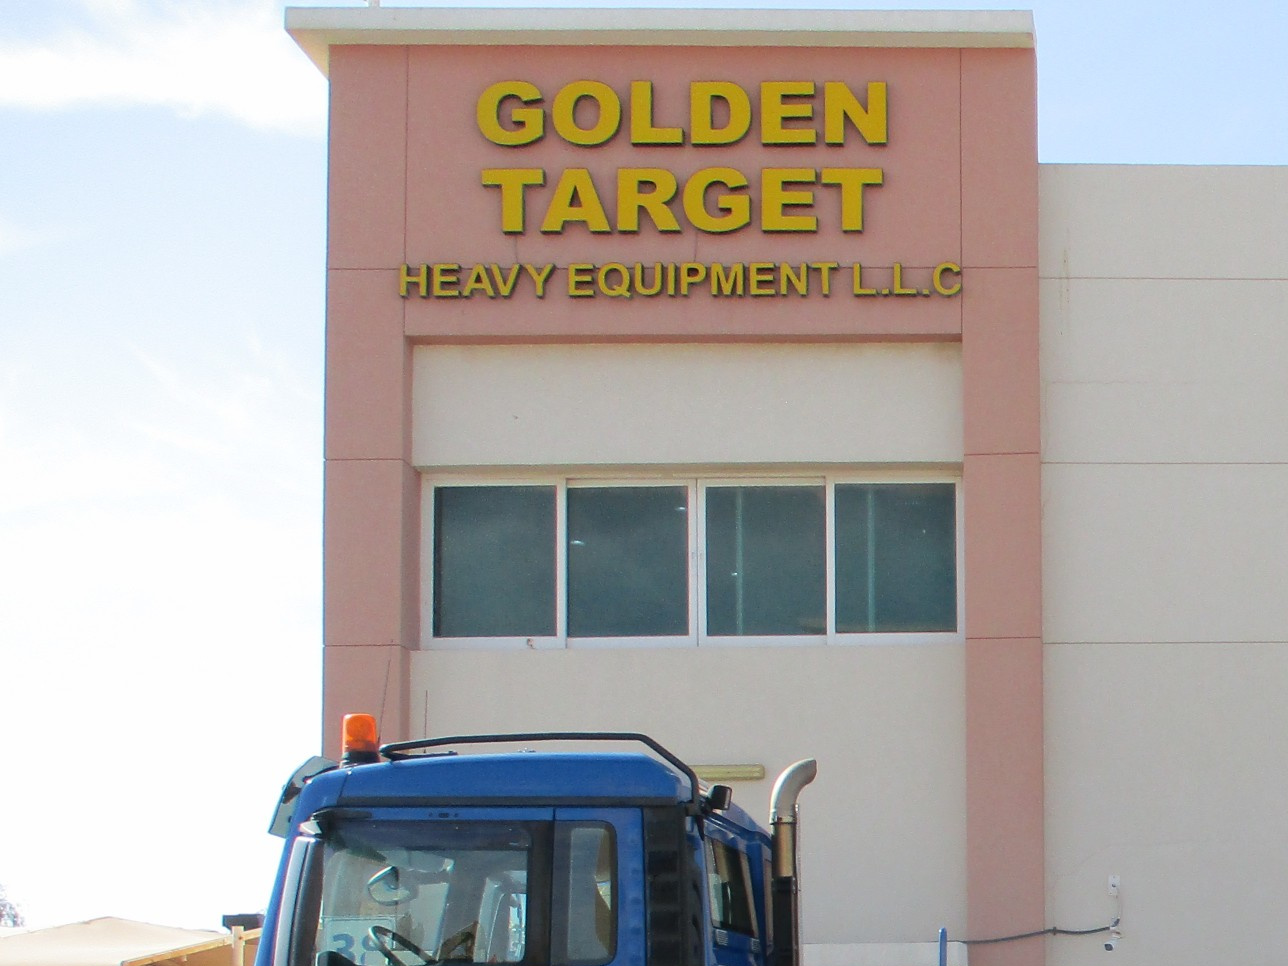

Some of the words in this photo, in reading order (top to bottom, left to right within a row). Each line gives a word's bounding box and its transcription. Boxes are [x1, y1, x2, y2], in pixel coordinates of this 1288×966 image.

[477, 80, 888, 147] GOLDEN
[481, 166, 883, 235] TARGET
[399, 261, 555, 298] HEAVY
[567, 261, 838, 298] EQUIPMENT
[852, 262, 963, 297] L.L.C
